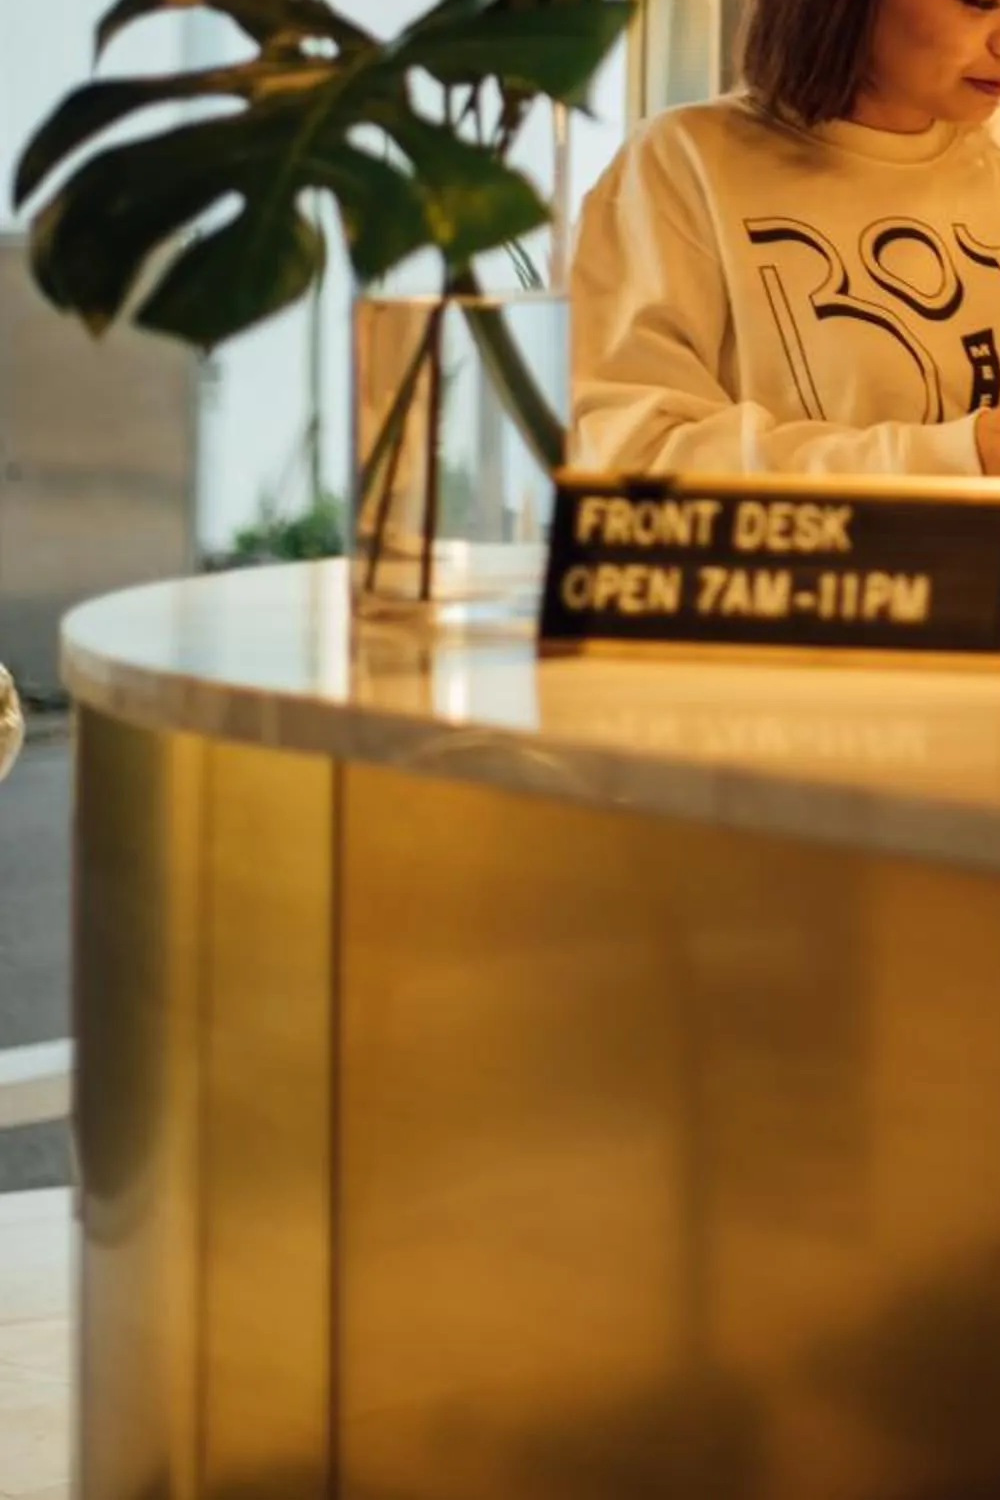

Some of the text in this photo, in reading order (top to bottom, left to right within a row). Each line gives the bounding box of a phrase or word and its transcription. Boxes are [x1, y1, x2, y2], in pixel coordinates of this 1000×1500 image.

[577, 496, 853, 553] FRONT DESK
[561, 563, 932, 623] OPEN 7AM-11PM
